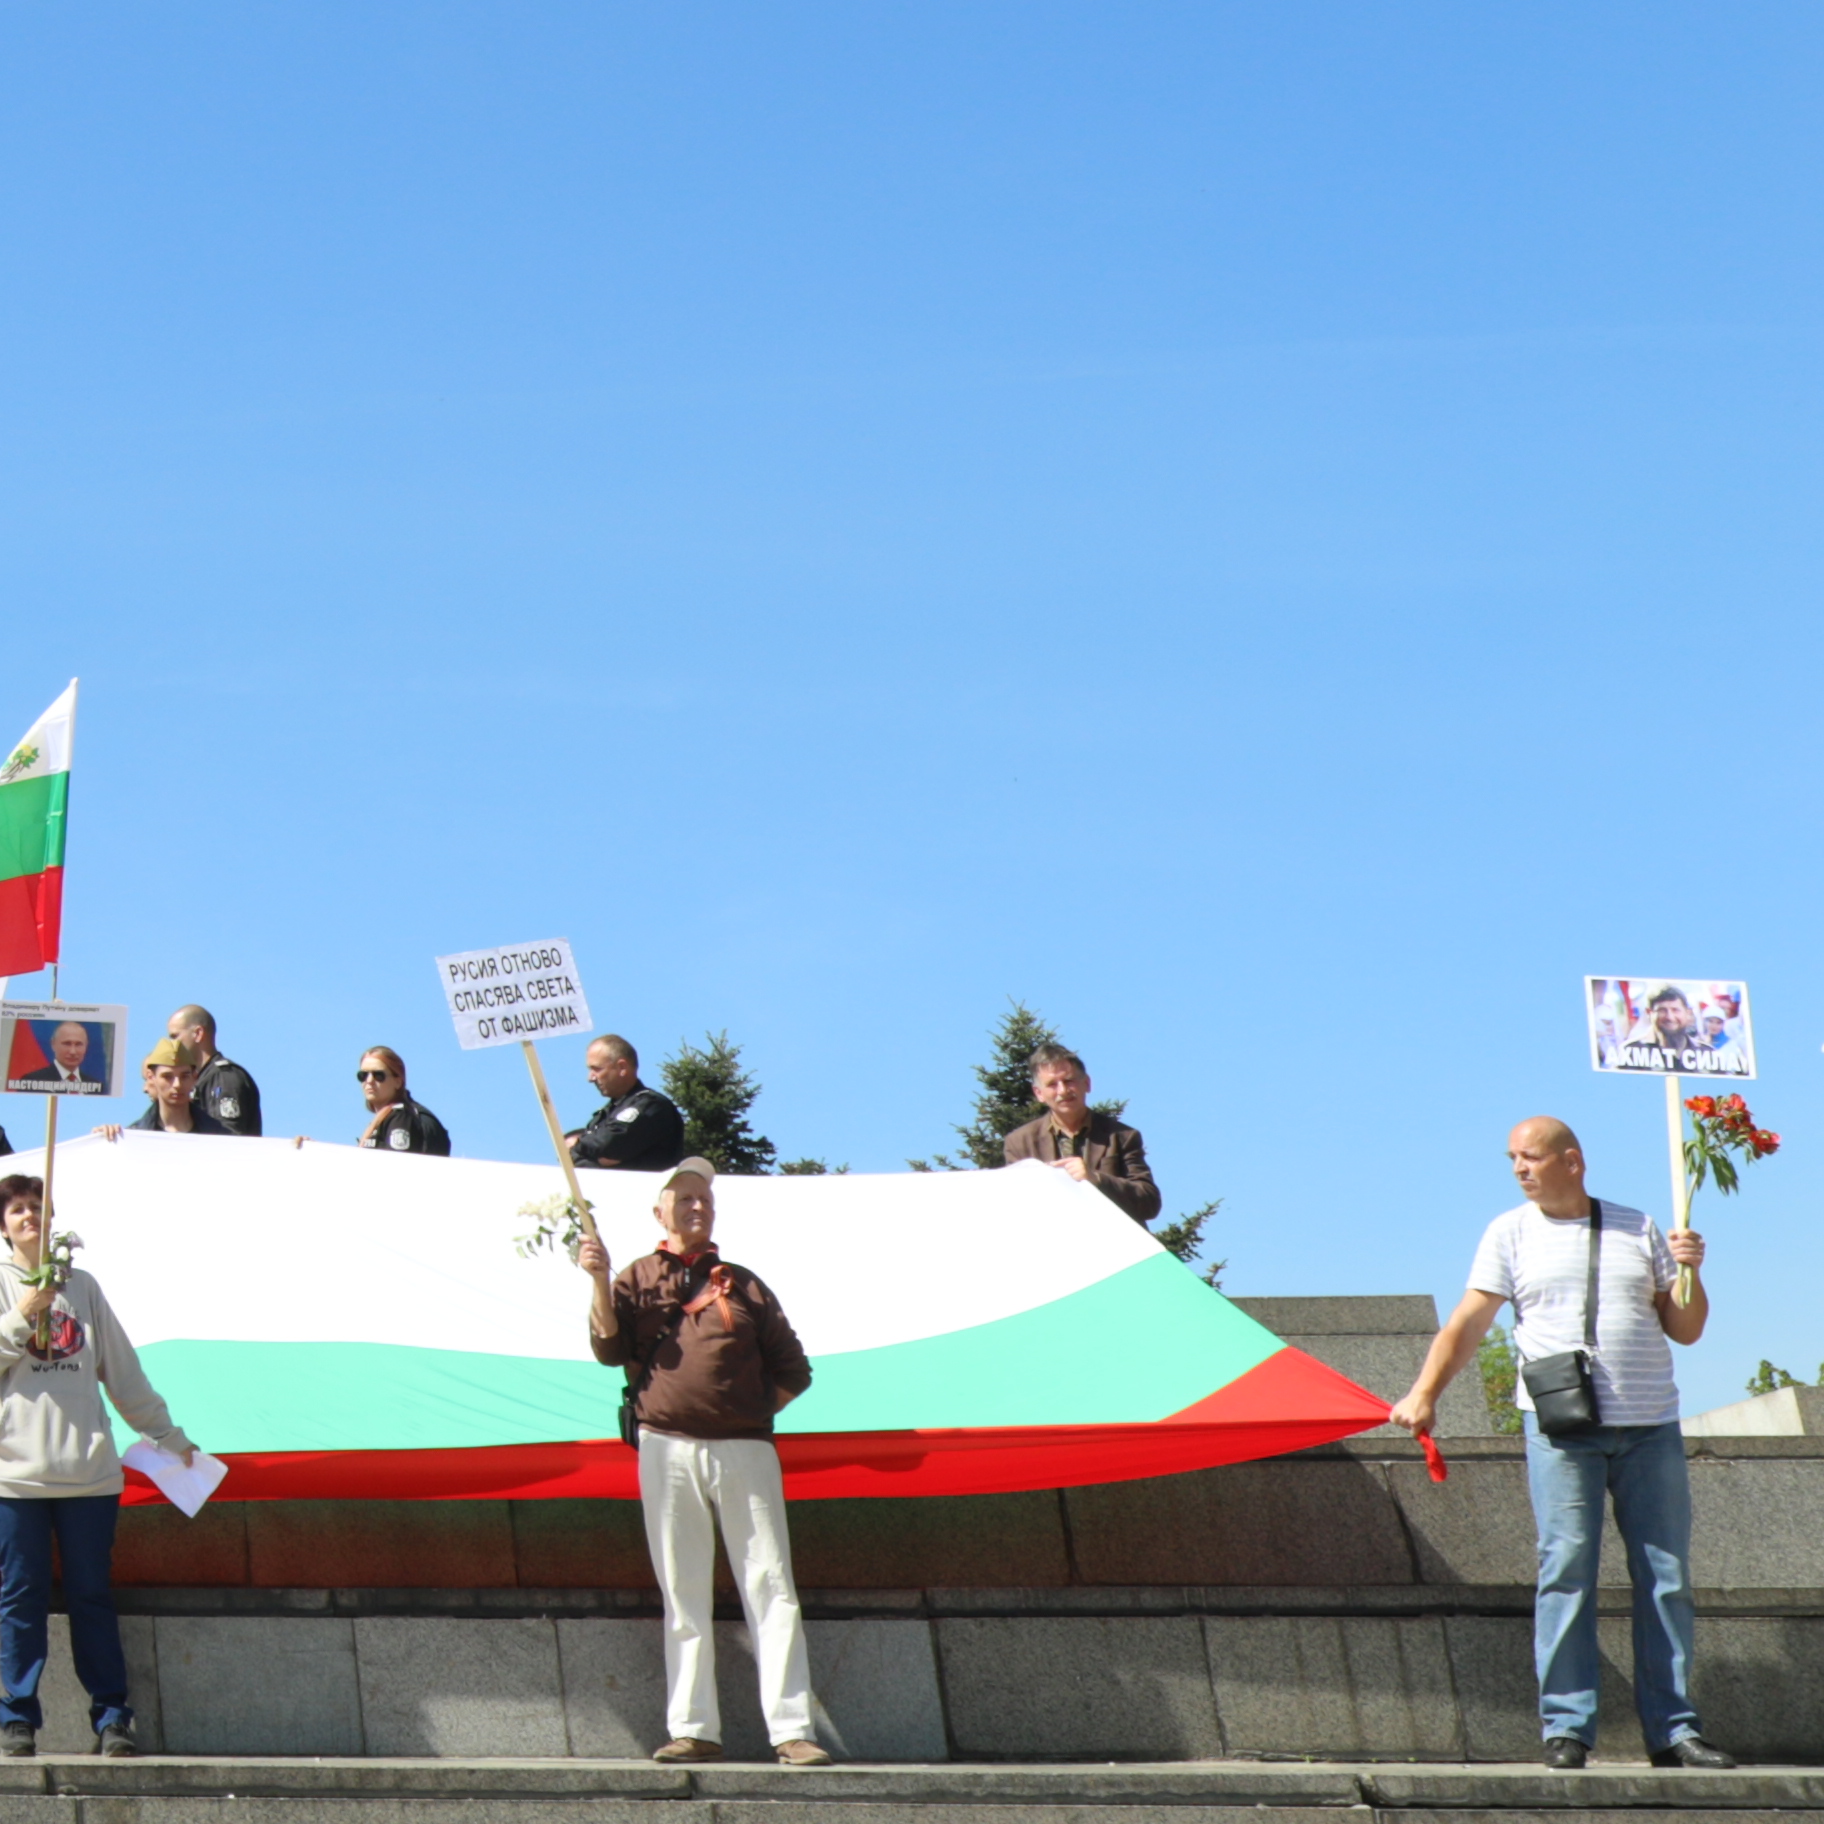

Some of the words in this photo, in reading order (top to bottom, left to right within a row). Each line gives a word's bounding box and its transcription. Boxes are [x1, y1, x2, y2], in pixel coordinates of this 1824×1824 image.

[448, 957, 500, 983] РУСИЯ
[501, 947, 562, 975] ОТНОВО
[454, 984, 526, 1012] СПАСЯВА
[527, 976, 577, 1001] СВЕТА
[478, 1018, 498, 1039] ОТ
[502, 1006, 579, 1034] ФАШИЗМА
[1605, 1046, 1677, 1068] АХМАТ
[8, 1079, 66, 1092] НАСТОЯЩИЙ
[67, 1080, 102, 1093] ЛИДЕР!
